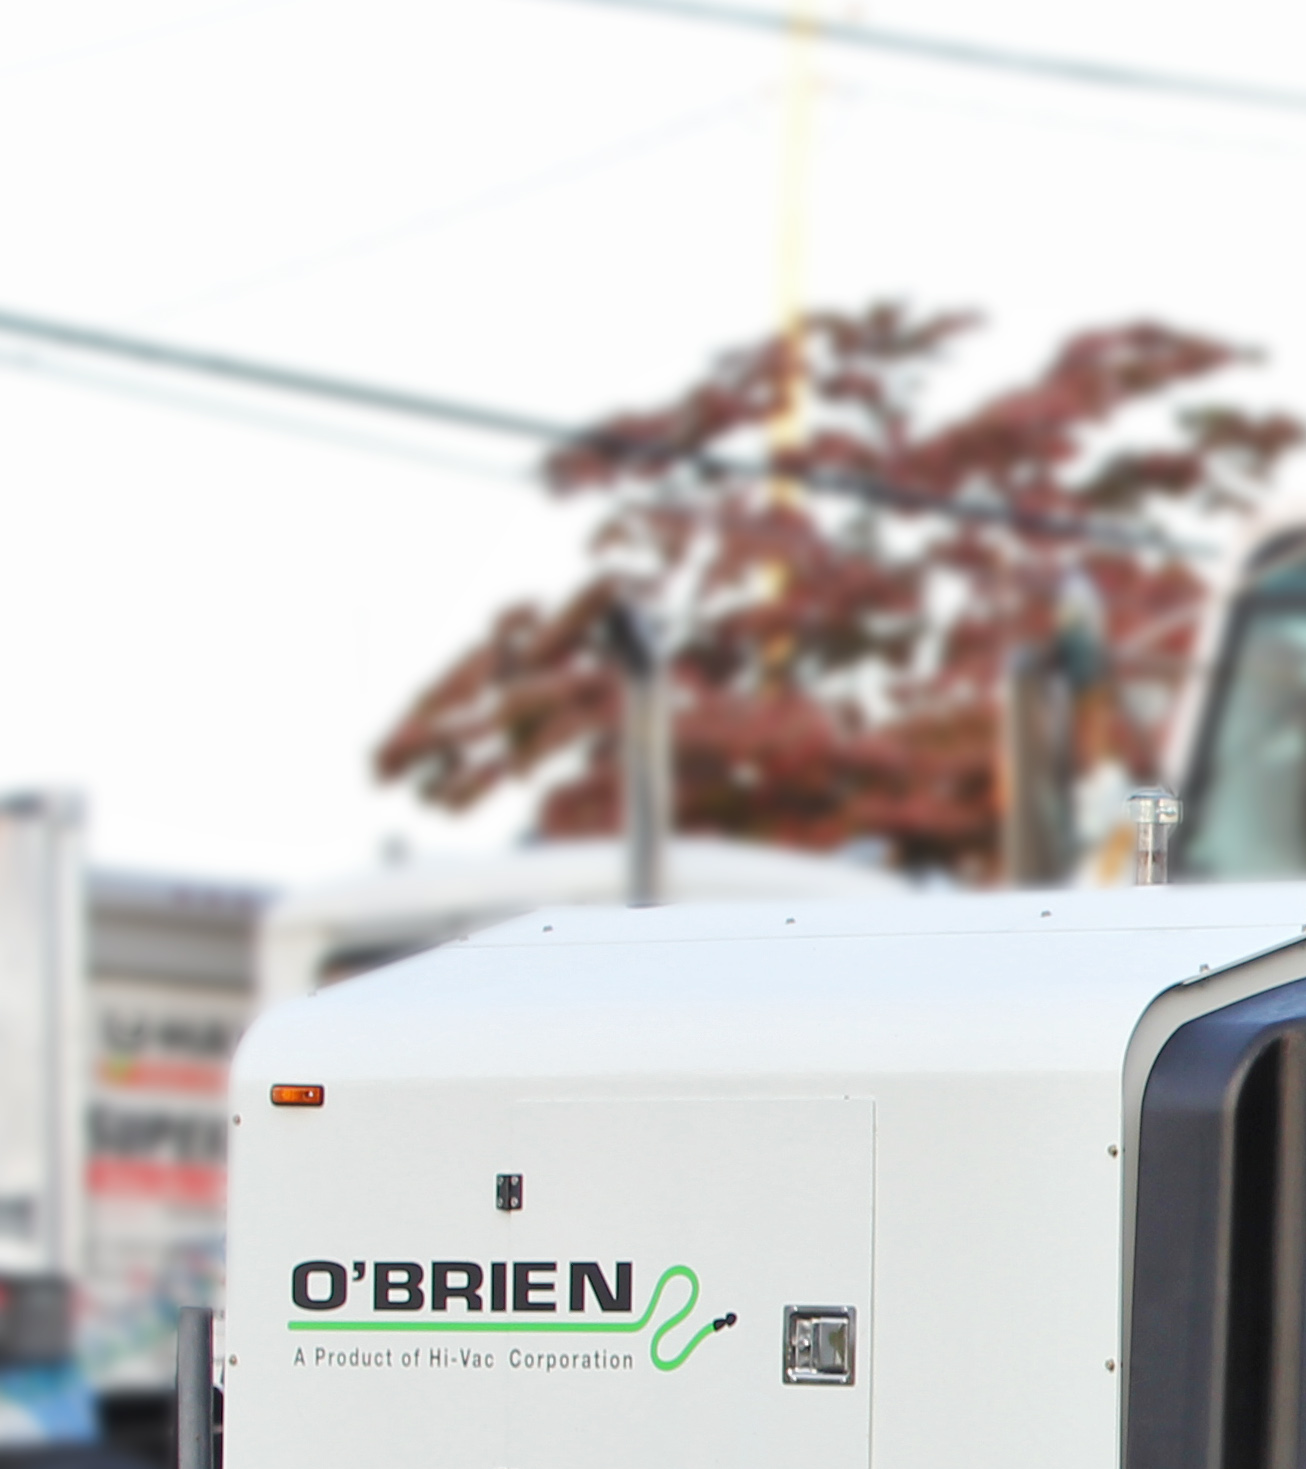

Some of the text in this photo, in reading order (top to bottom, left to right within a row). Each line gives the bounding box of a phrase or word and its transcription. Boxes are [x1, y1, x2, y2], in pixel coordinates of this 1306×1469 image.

[291, 1260, 633, 1313] O'BRIEN
[294, 1347, 634, 1372] A Product of Hi-Vac Corporation
